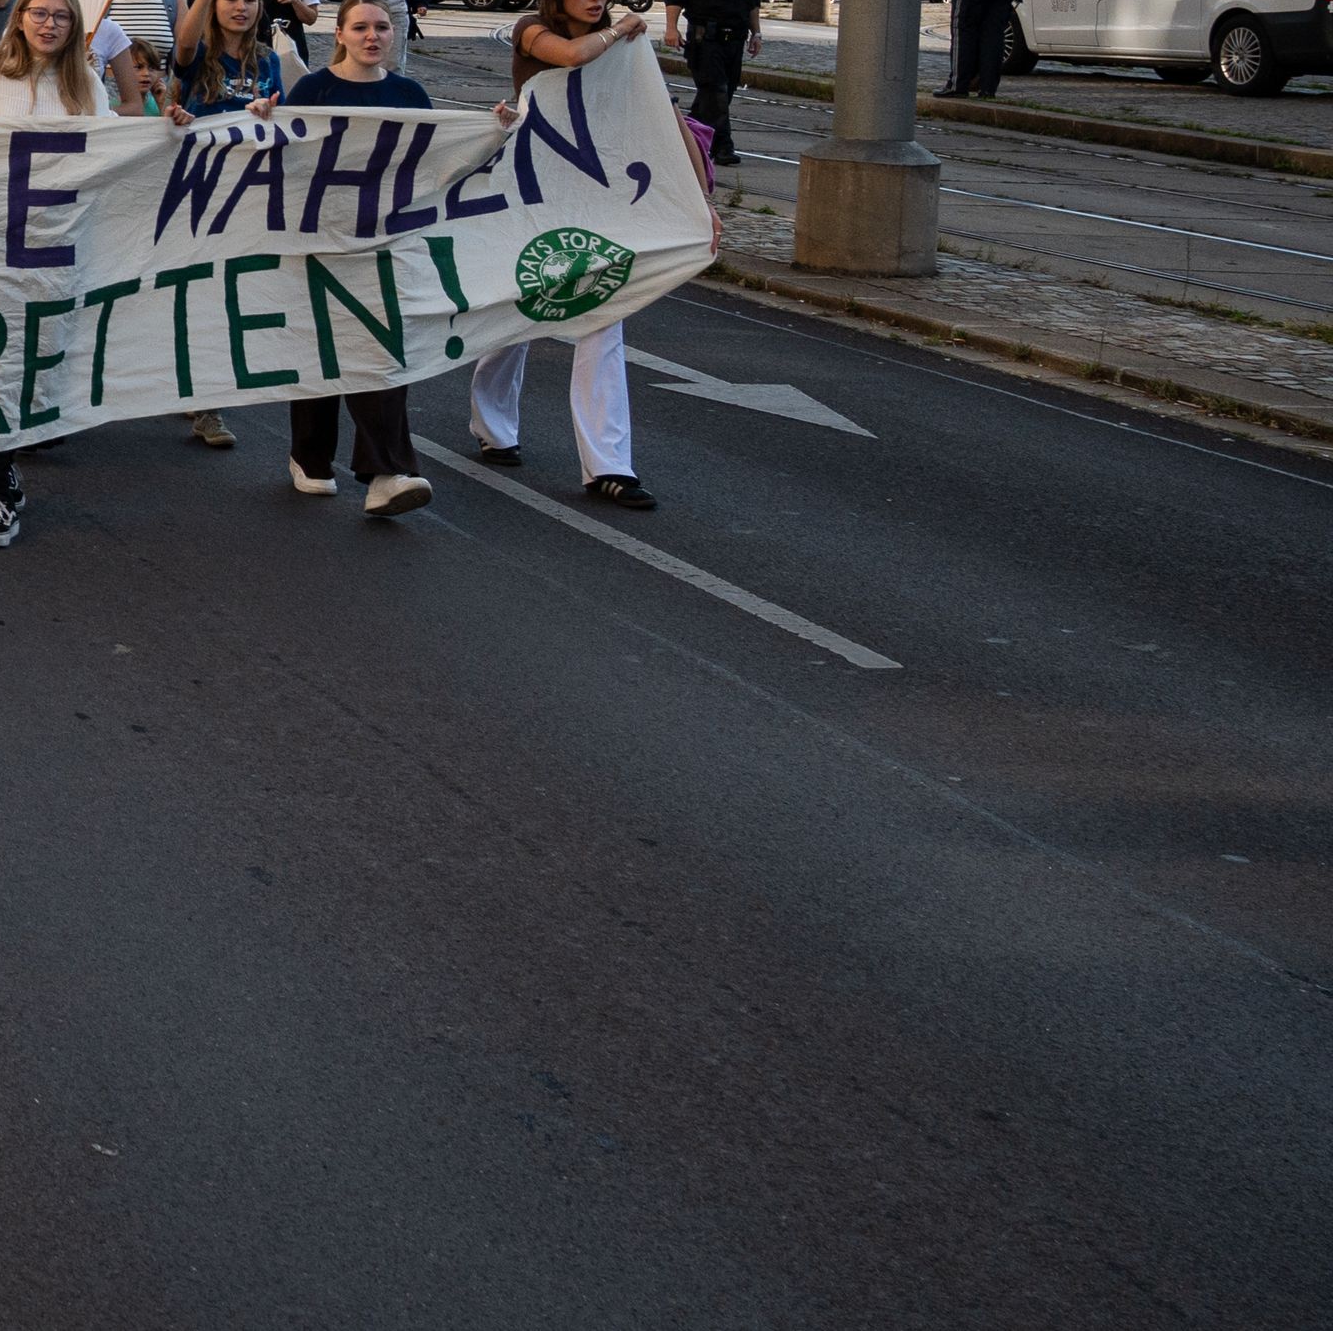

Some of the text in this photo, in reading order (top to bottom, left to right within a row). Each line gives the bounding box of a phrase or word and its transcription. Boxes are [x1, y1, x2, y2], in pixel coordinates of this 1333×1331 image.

[154, 67, 652, 245] WÄHLEN,
[557, 232, 601, 252] FOR
[531, 297, 567, 319] Wien
